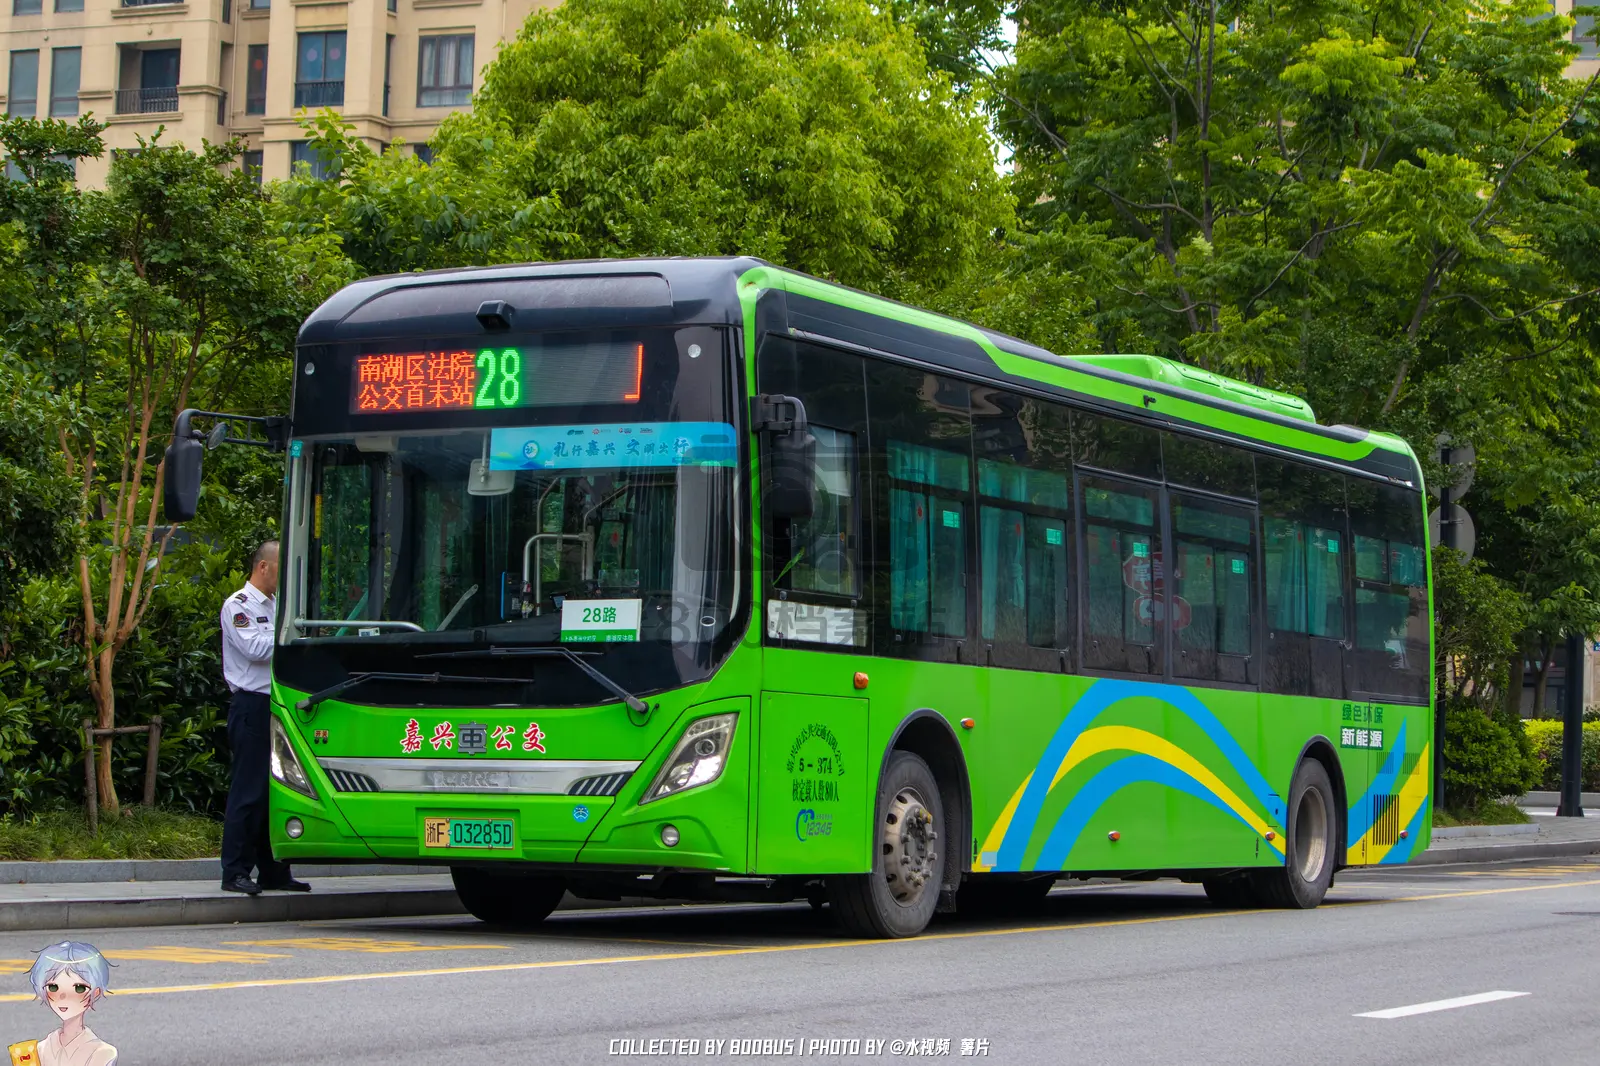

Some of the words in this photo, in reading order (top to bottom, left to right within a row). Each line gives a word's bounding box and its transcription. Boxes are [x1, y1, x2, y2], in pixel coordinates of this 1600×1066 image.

[358, 352, 475, 382] 南湖区法院
[476, 349, 520, 407] 28
[358, 380, 475, 411] 公交首末站
[582, 606, 617, 623] 28路
[1342, 704, 1383, 723] 绿色环保
[1341, 728, 1383, 747] 新能源
[807, 821, 833, 837] 12345
